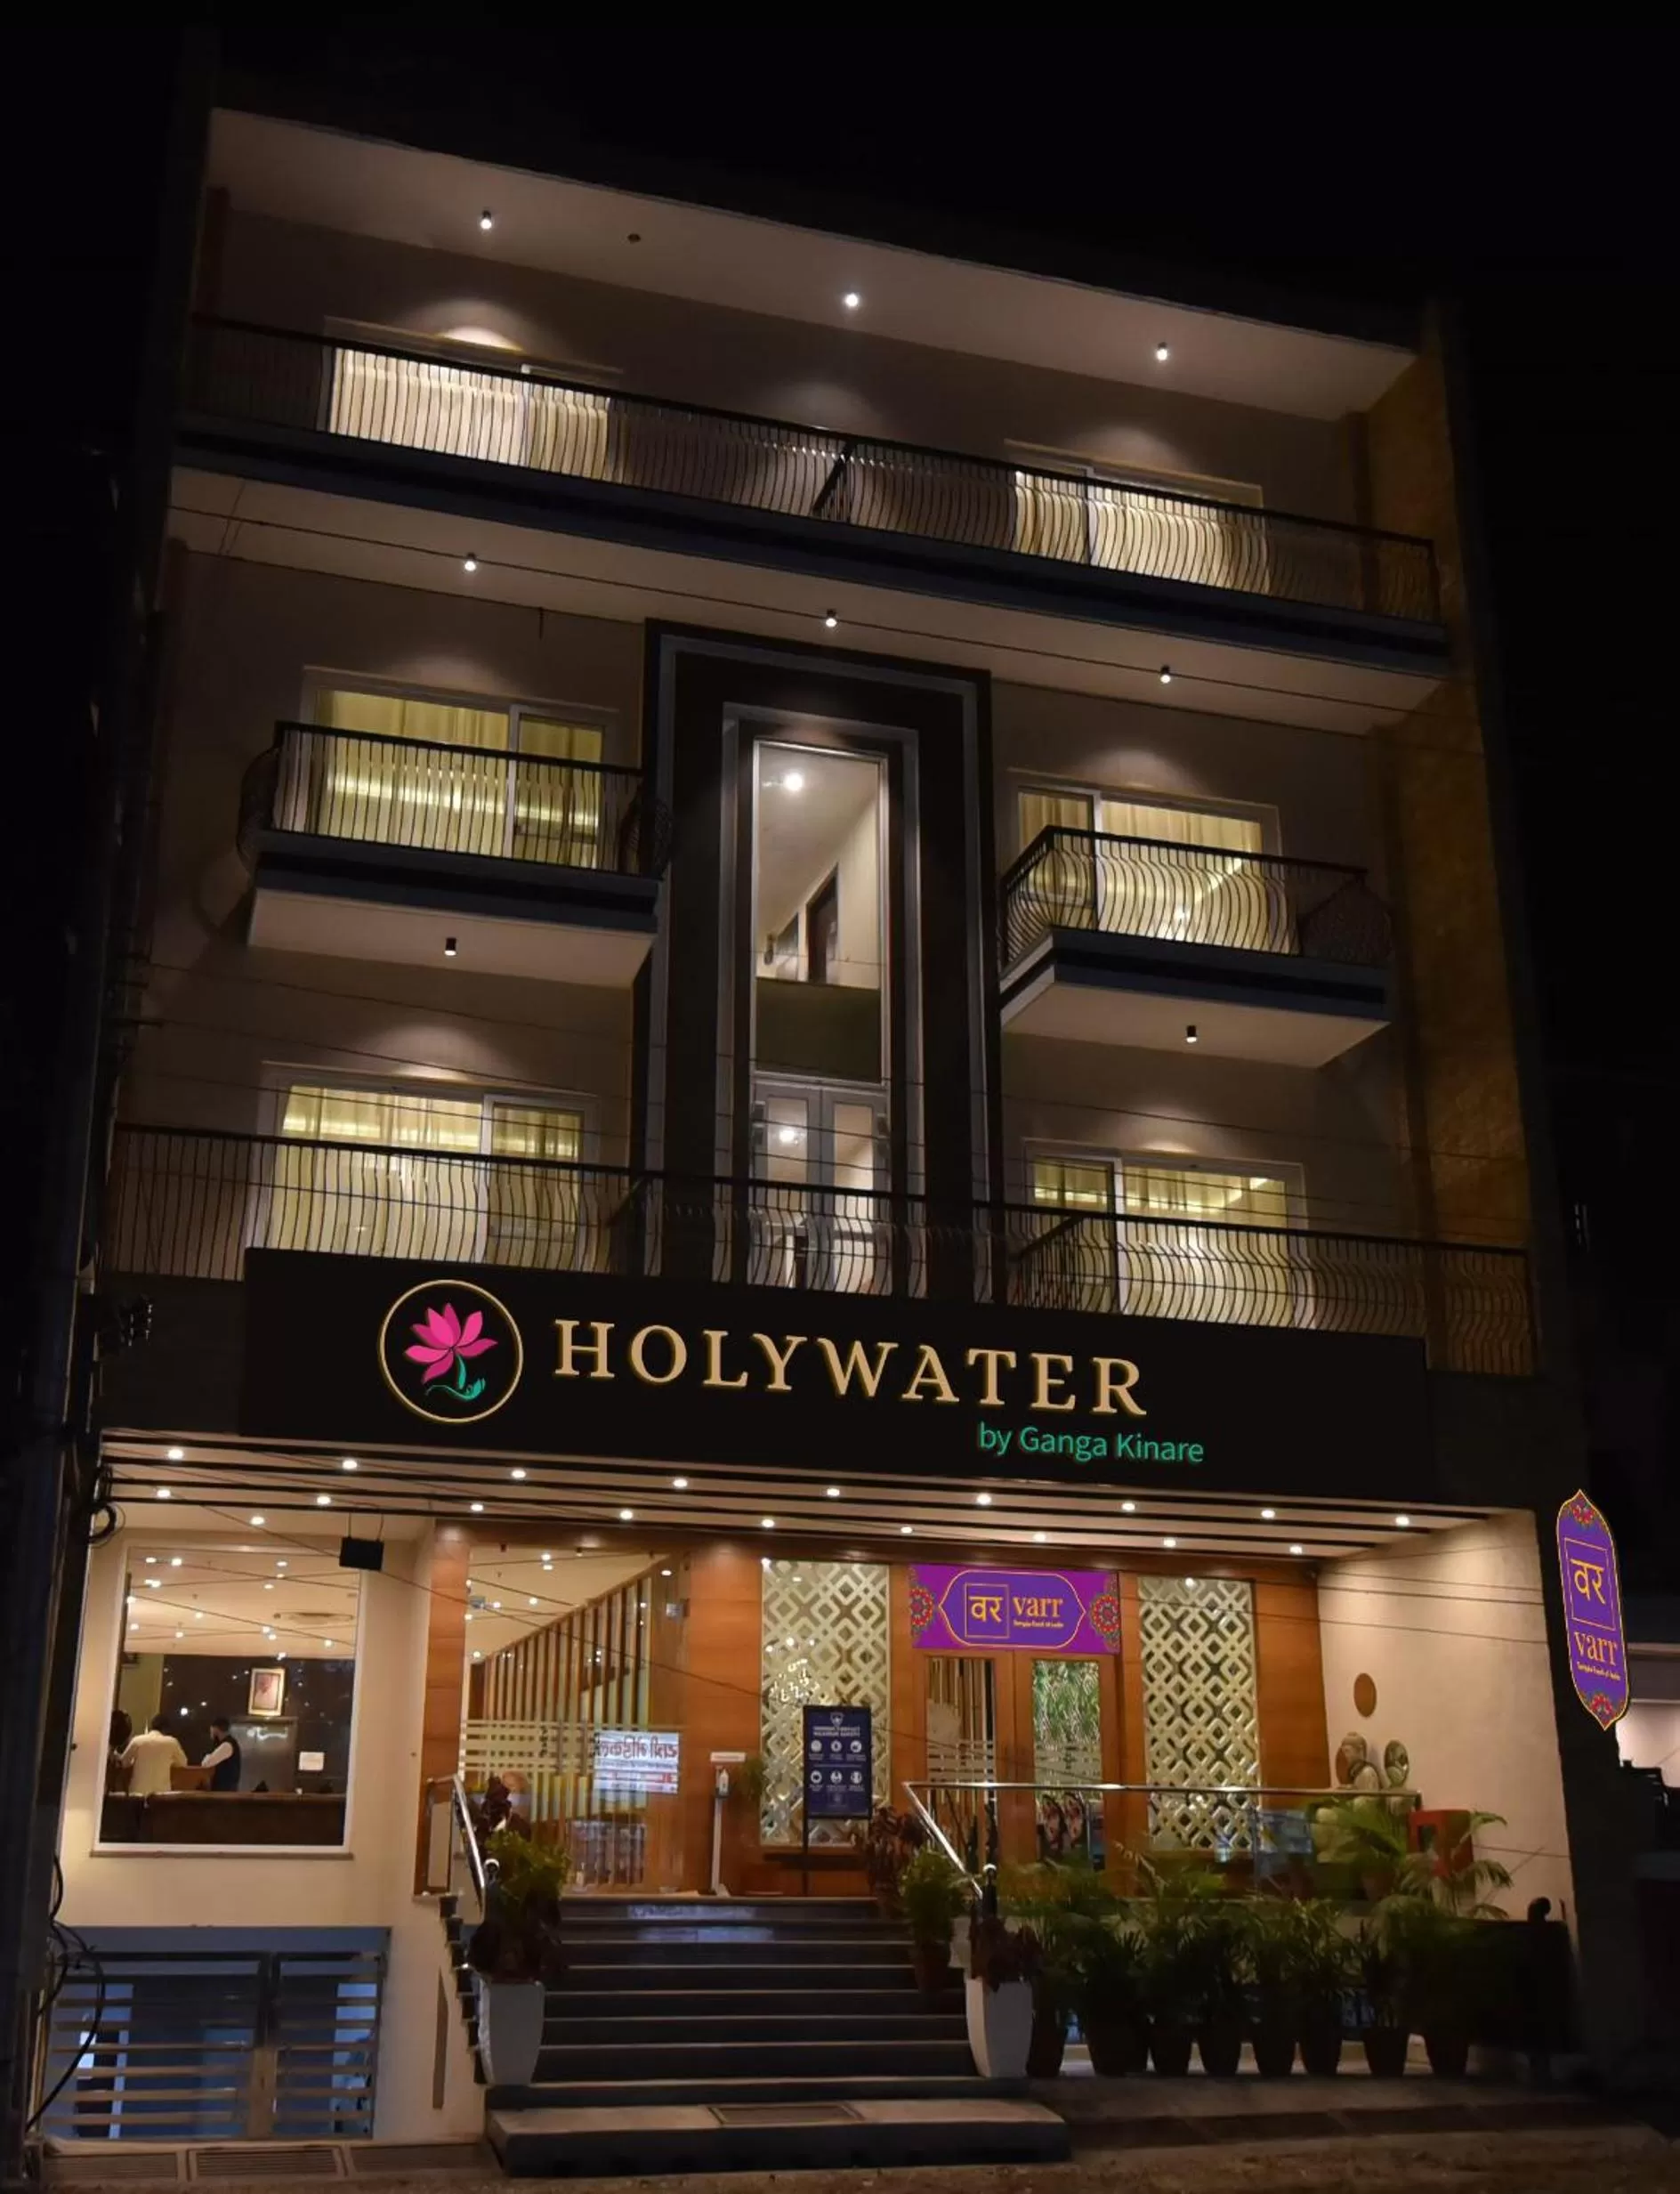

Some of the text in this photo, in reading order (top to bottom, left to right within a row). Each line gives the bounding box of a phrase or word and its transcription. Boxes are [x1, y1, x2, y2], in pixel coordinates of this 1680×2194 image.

[553, 1318, 1147, 1415] HOLYWATER
[979, 1422, 1204, 1462] by Ganga Kinare
[1571, 1558, 1605, 1605] वर
[968, 1596, 1004, 1623] वर
[1013, 1597, 1063, 1617] varr
[1573, 1631, 1618, 1667] varr
